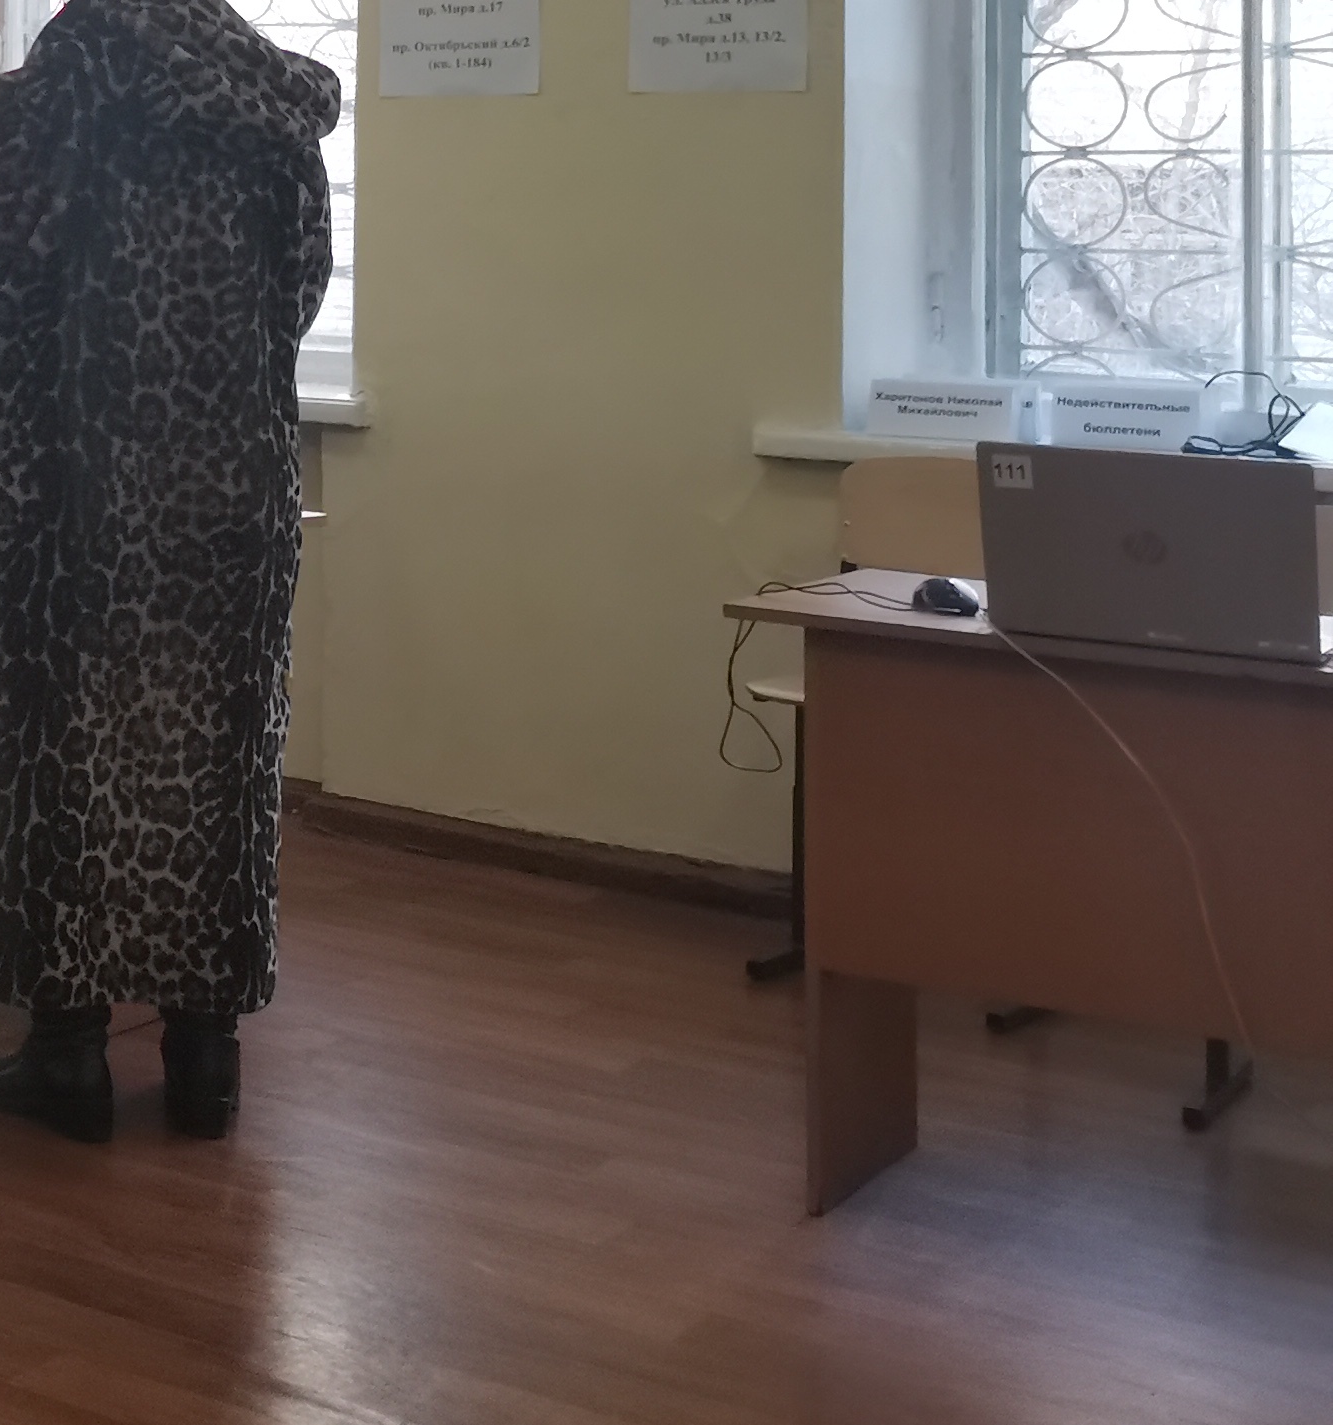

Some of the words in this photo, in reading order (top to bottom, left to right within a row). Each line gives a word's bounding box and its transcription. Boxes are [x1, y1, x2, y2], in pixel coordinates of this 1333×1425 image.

[418, 4, 437, 18] пр.
[440, 2, 475, 16] Мира
[479, 1, 504, 14] д.17
[392, 43, 411, 55] пр.
[414, 38, 498, 53] Октябрьский
[677, 32, 716, 45] Мира
[428, 59, 452, 71] (кв.
[455, 57, 493, 70] 1-184)
[875, 391, 944, 404] Харитонов
[947, 395, 1003, 408] Николай
[1056, 396, 1191, 414] Недействительные
[897, 405, 978, 418] Михайлович
[1083, 422, 1162, 437] бюллетени
[994, 462, 1026, 480] 111
